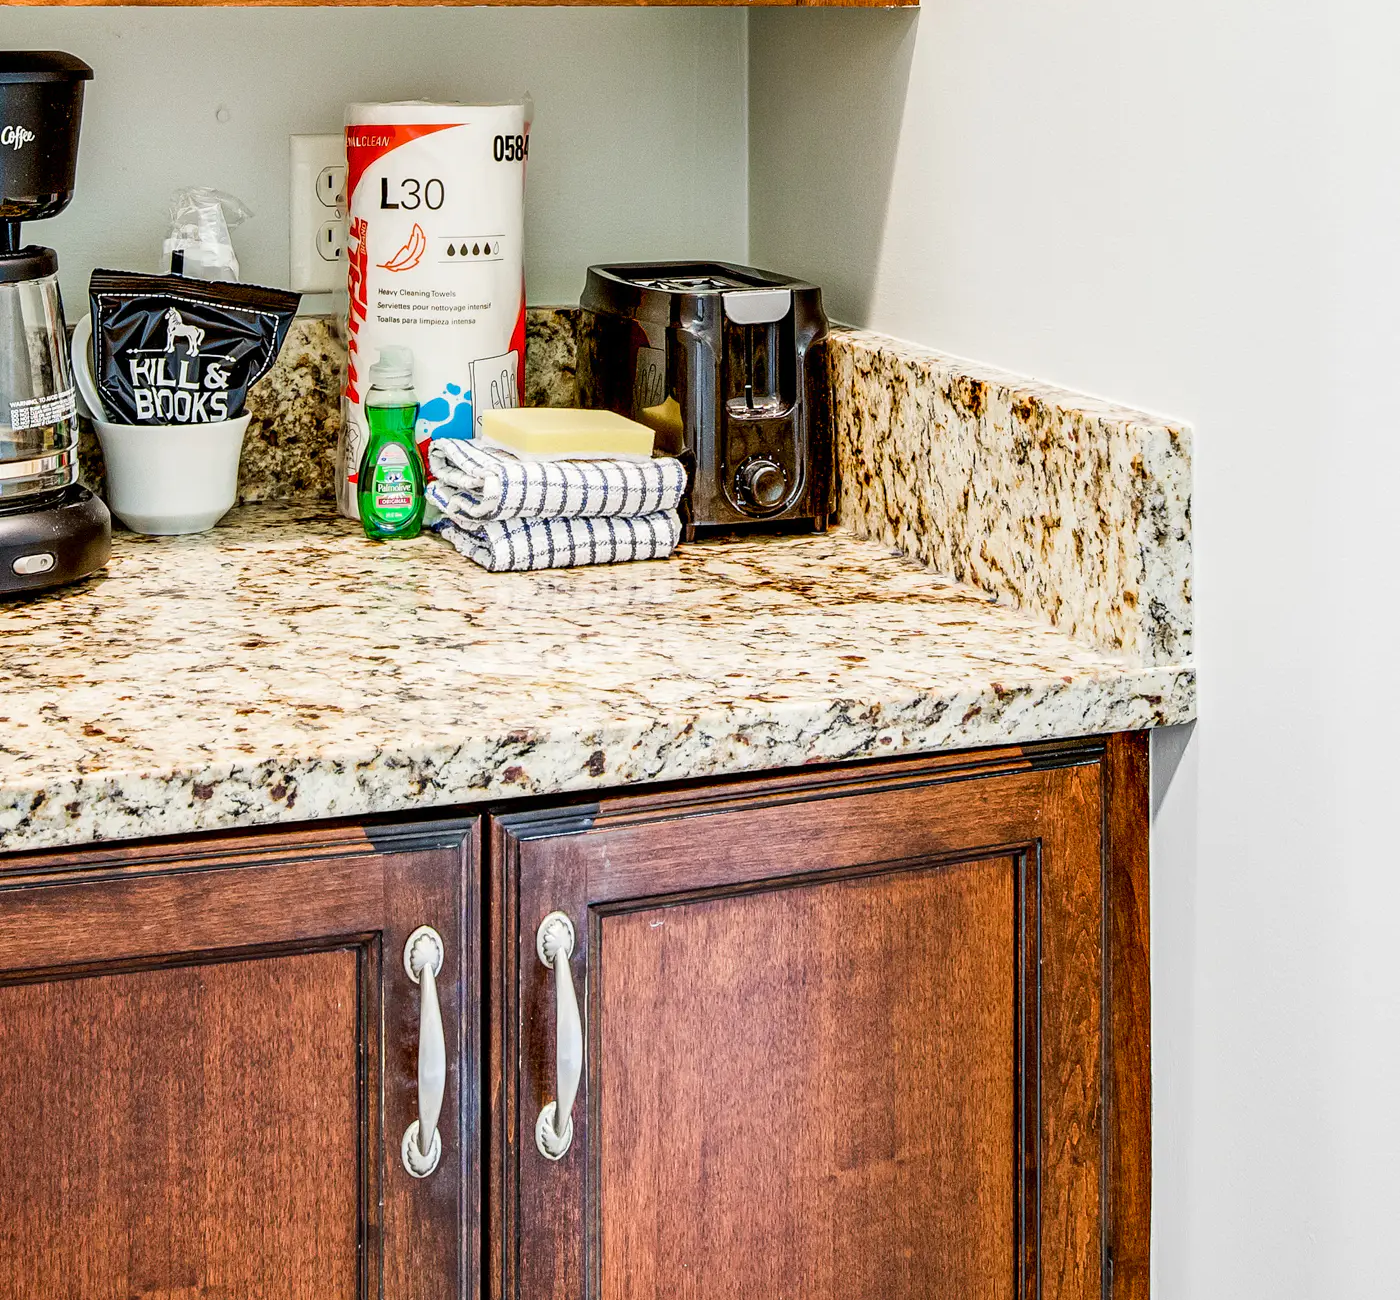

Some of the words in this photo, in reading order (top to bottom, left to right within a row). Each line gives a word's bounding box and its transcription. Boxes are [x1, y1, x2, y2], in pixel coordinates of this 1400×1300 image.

[1, 125, 35, 150] Coffee
[493, 134, 529, 162] 0584
[380, 177, 445, 210] L30
[378, 288, 398, 296] Heavy
[399, 289, 431, 298] Cleaning
[377, 302, 410, 310] Serviettes
[431, 304, 466, 312] nettoyage
[467, 302, 492, 310] intensif
[377, 315, 400, 323] Toallas
[419, 318, 449, 326] limpieza
[204, 362, 231, 389] &
[377, 483, 412, 493] Palmolive
